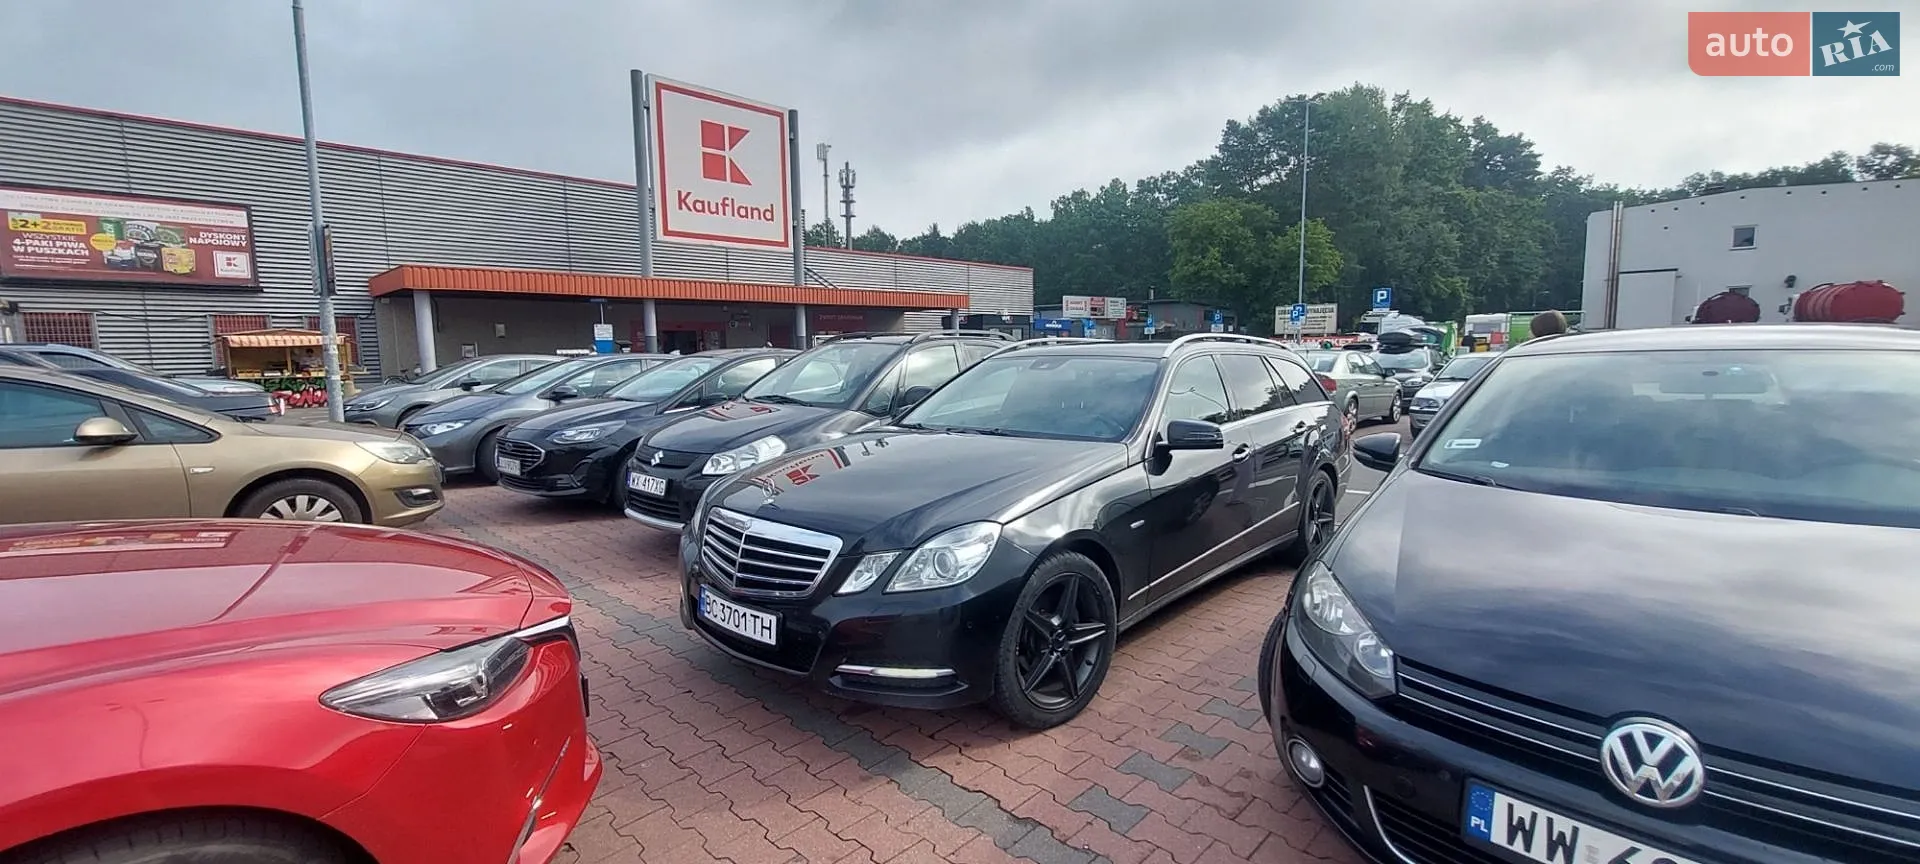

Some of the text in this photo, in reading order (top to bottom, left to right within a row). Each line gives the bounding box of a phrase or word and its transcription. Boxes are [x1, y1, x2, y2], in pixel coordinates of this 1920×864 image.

[677, 190, 775, 222] Kaufland
[22, 232, 77, 242] WSZYSTKIE
[189, 237, 247, 247] NAPOJOWY
[13, 238, 53, 247] 4-PAKI
[56, 240, 87, 249] PIWA
[28, 246, 89, 256] PUSZKACH
[1377, 290, 1388, 303] P
[1470, 816, 1489, 834] PL
[1506, 802, 1580, 864] WW
